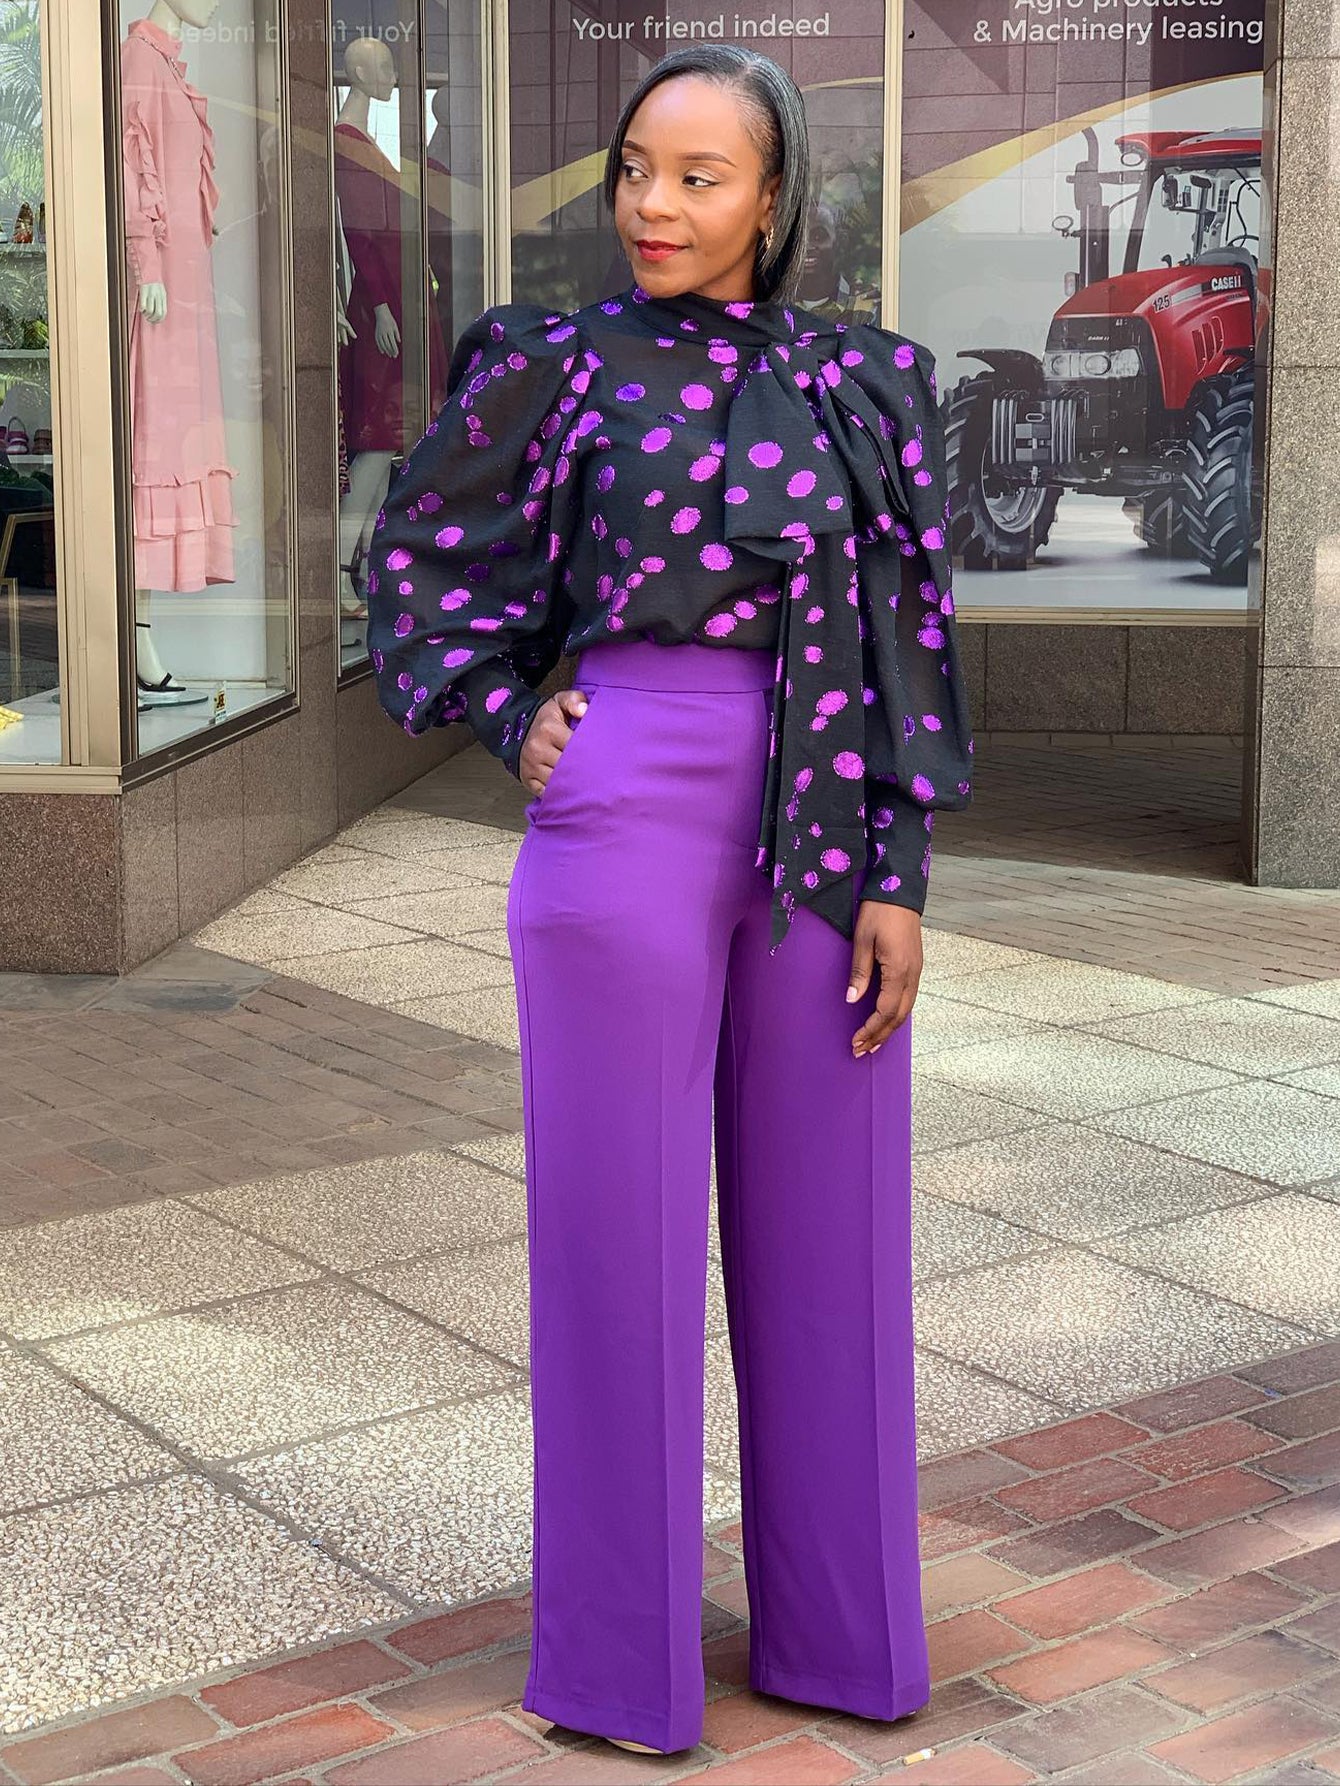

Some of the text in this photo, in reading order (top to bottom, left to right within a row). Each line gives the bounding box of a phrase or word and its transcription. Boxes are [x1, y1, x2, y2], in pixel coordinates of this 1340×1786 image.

[572, 13, 830, 40] Your friend indeed
[973, 14, 1264, 45] & Machinery leasing
[1153, 295, 1170, 312] 125
